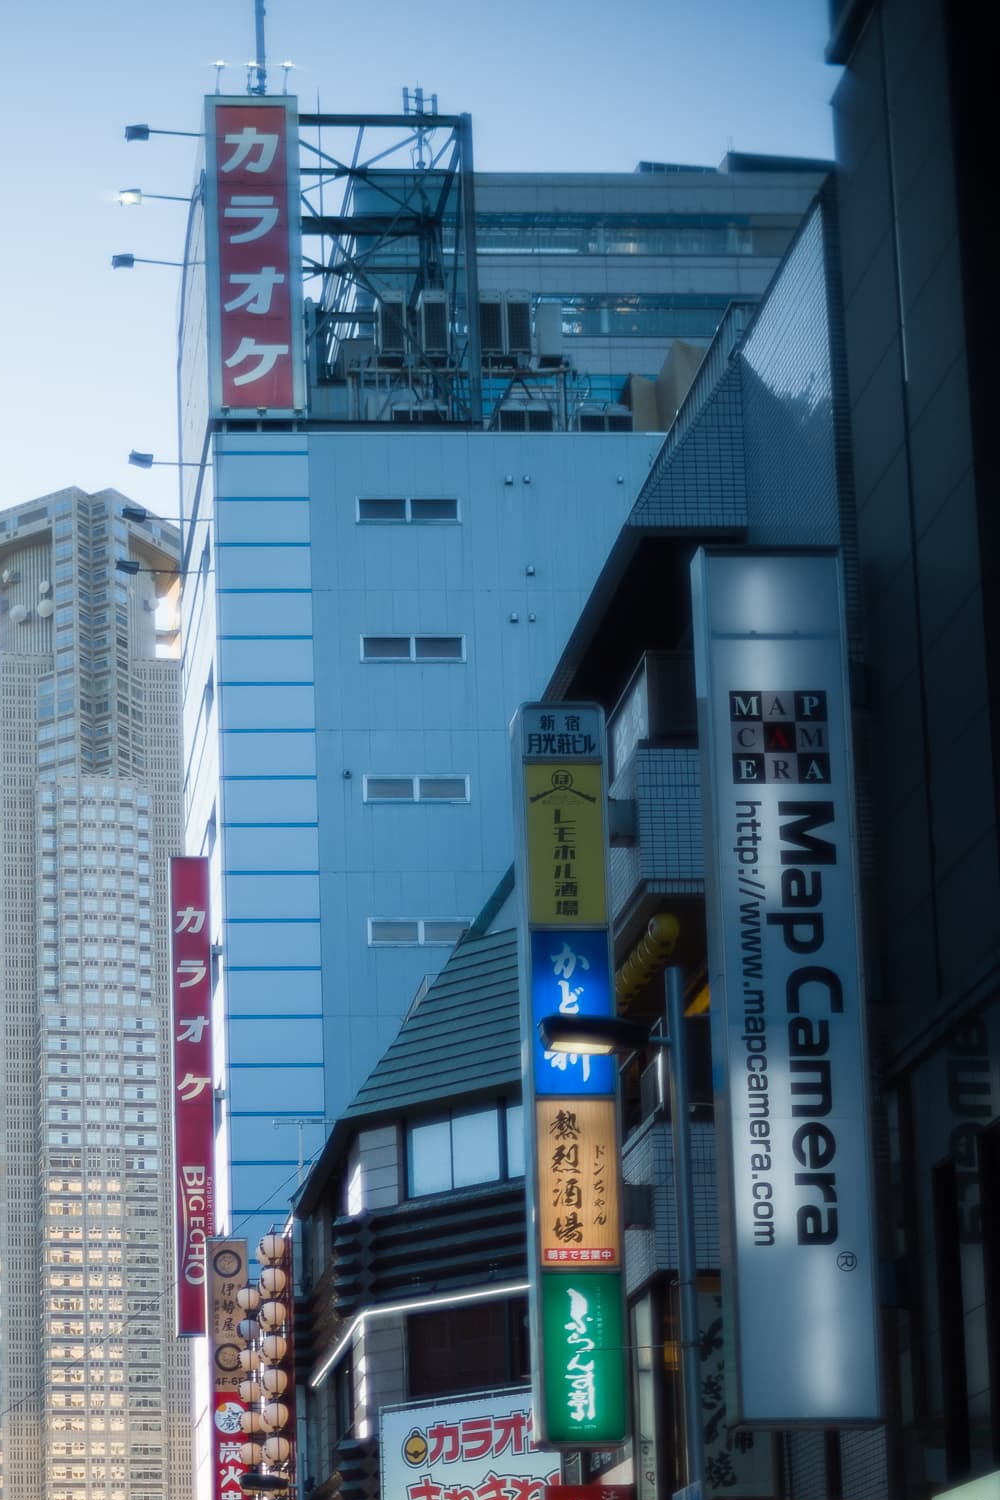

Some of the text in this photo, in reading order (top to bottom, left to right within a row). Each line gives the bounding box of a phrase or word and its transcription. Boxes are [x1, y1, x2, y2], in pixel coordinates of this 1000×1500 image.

[220, 126, 290, 388] カラオケ
[539, 714, 581, 732] 新宿
[731, 693, 825, 719] MAP
[737, 757, 830, 783] ERA
[552, 808, 579, 917] レモホル酒場
[176, 906, 212, 1103] カラオケ
[733, 800, 776, 1247] http://www.mapcamera.com
[766, 801, 843, 1247] Map Camera
[182, 1166, 206, 1285] BIG ECHO
